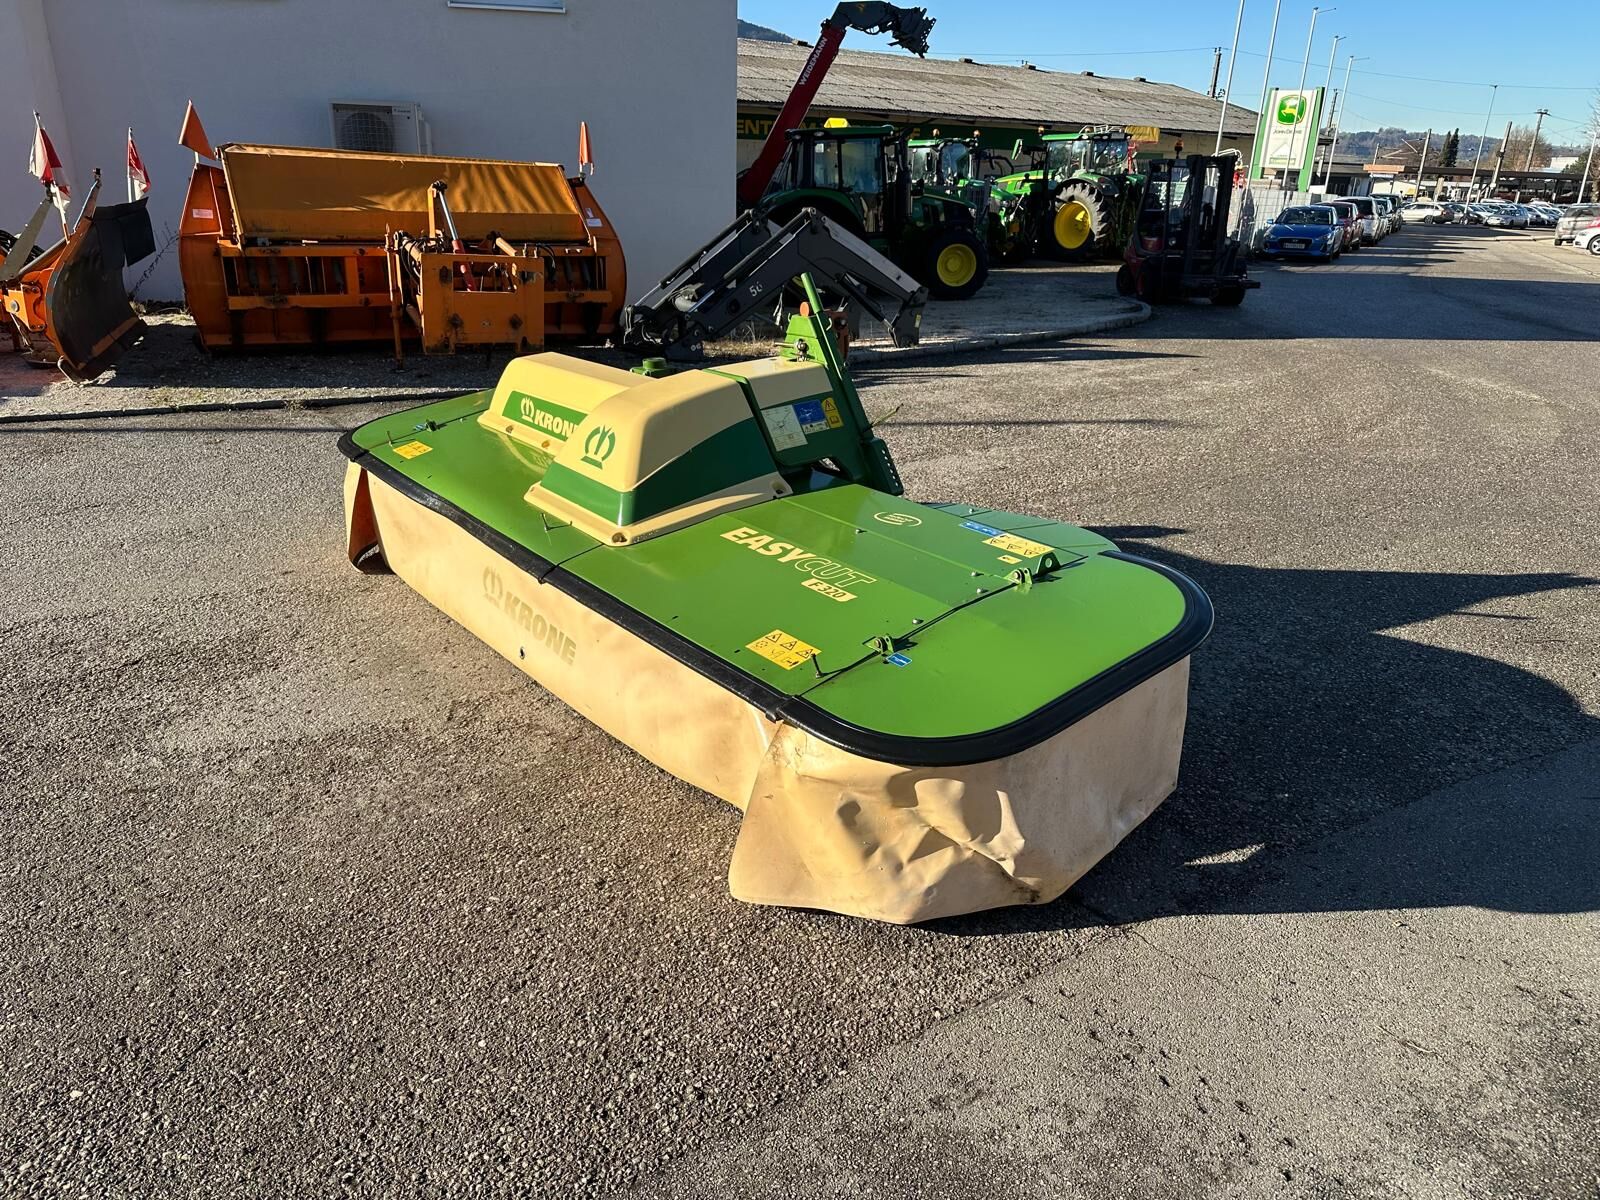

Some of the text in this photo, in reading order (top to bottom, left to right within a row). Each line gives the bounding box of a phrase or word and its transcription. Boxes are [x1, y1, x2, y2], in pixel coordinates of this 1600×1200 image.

[799, 36, 828, 85] WEIDEMANN
[534, 409, 579, 437] KRON
[719, 526, 877, 588] EASYCUT
[503, 590, 577, 667] KRONE
